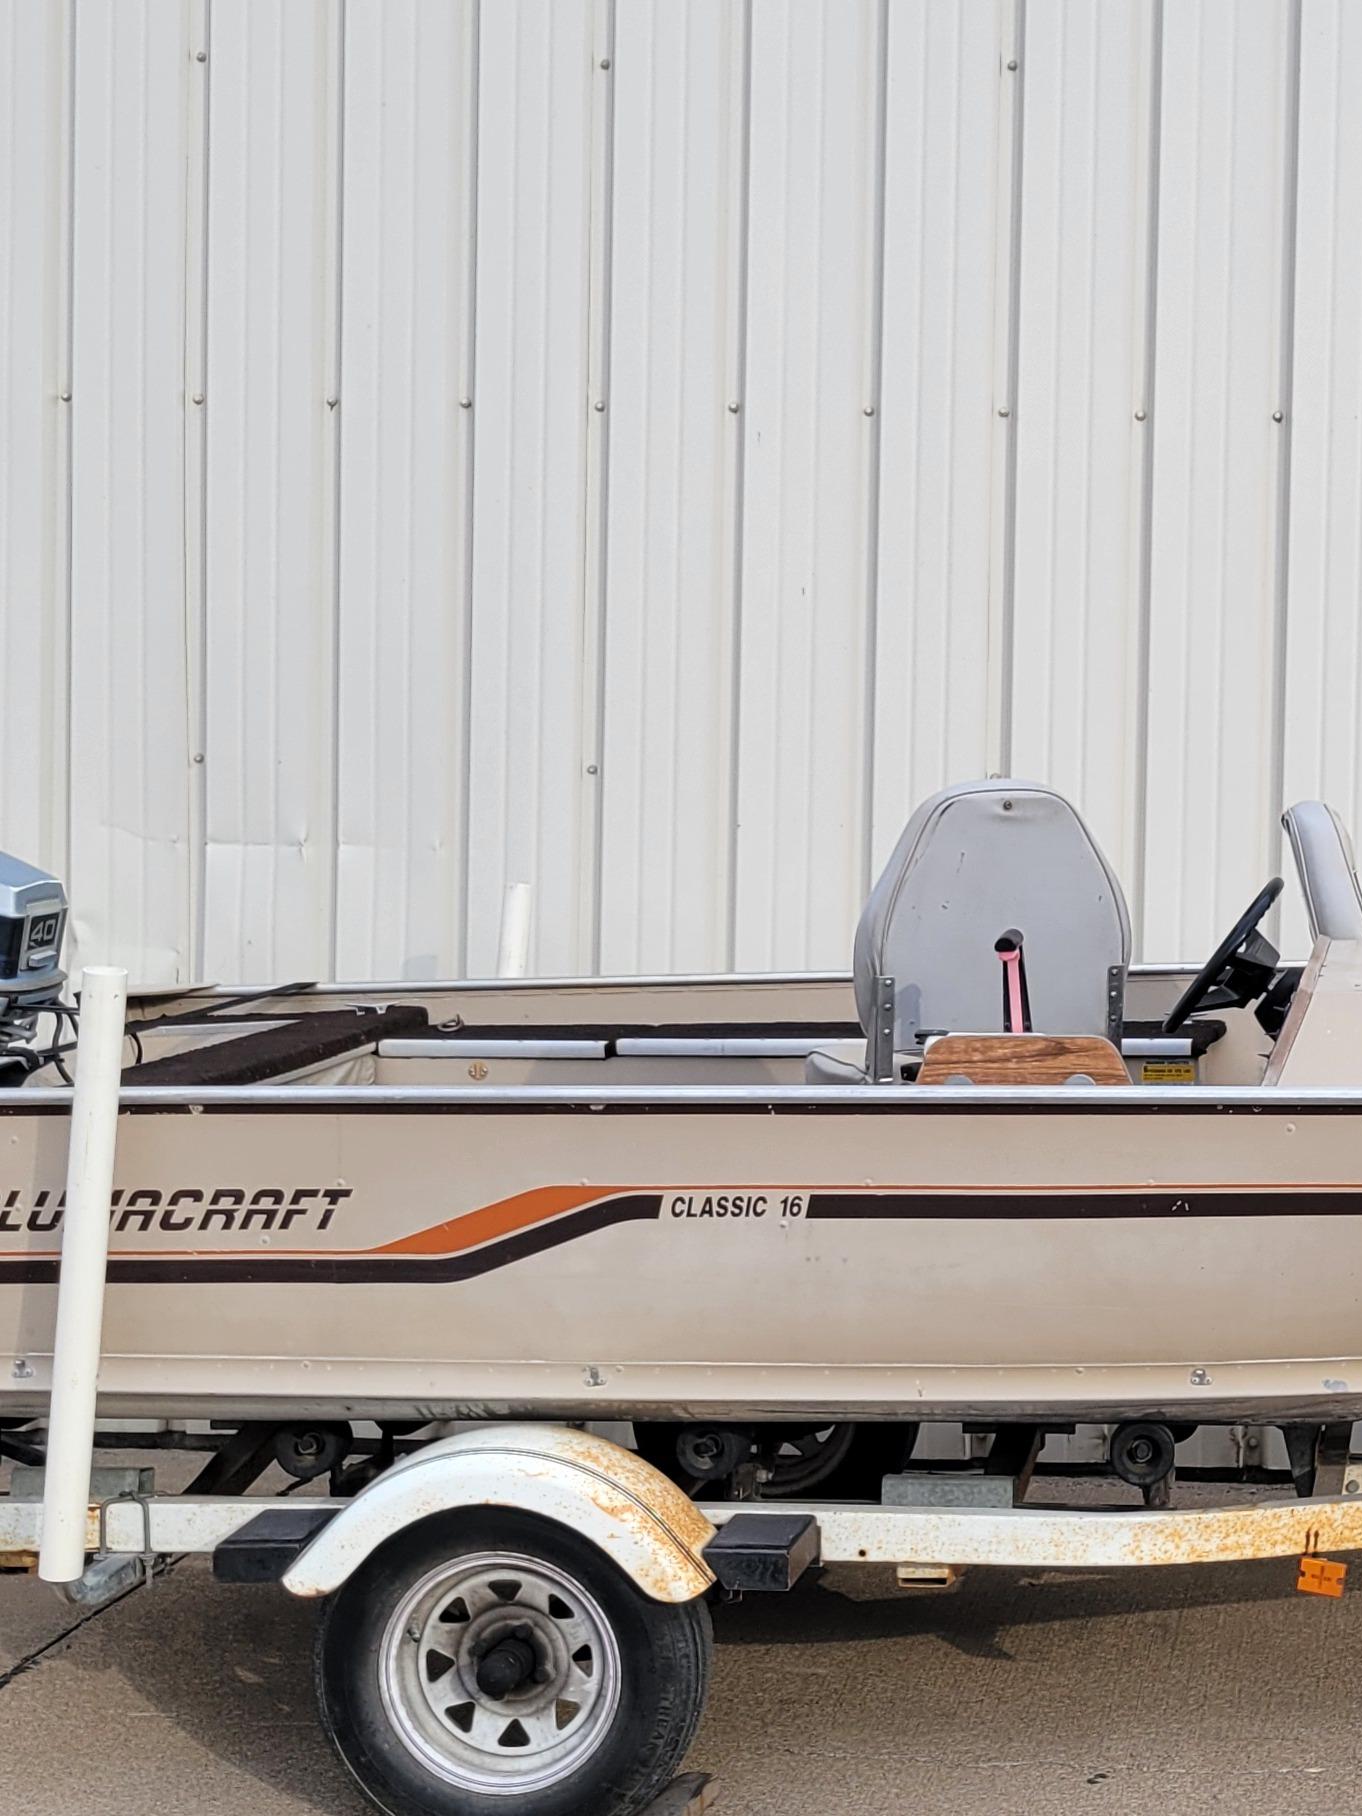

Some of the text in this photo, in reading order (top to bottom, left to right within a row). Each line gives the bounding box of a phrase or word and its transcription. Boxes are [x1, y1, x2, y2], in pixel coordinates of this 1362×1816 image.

[31, 919, 56, 941] 40
[0, 1188, 353, 1232] LUACRAFT
[671, 1194, 804, 1218] CLASSIC 16
